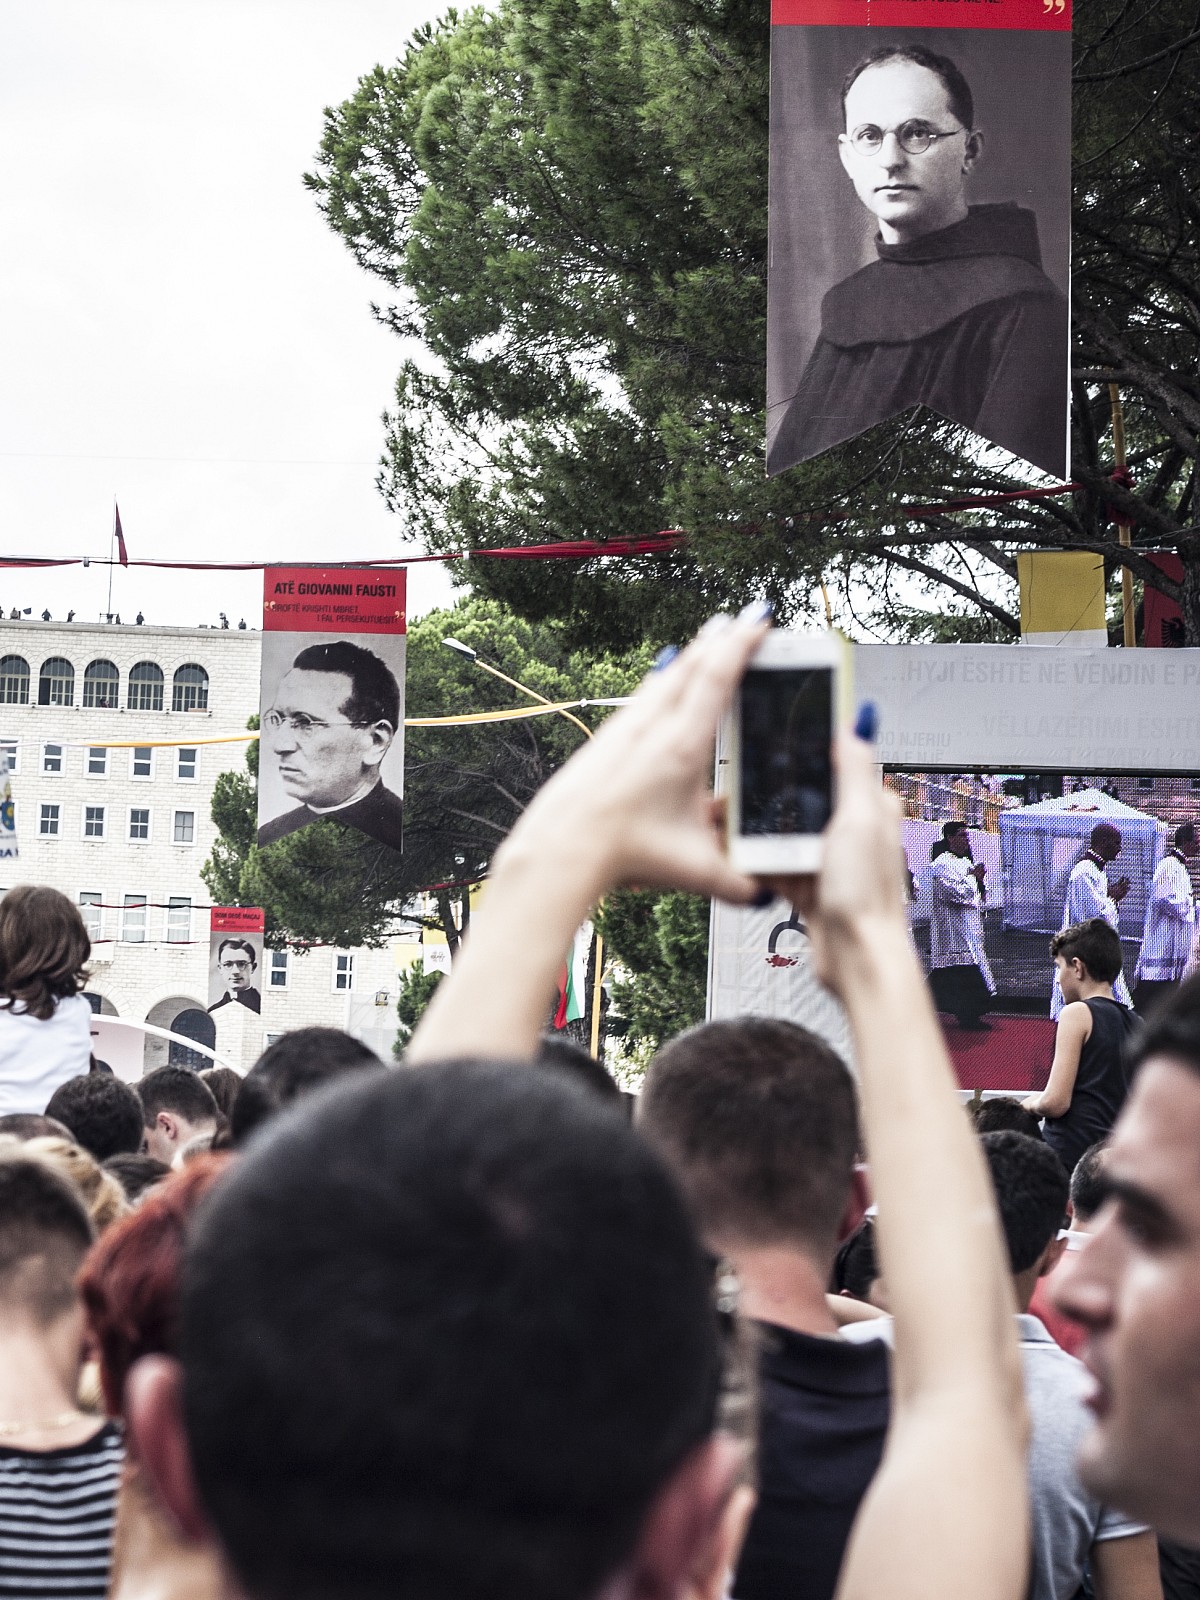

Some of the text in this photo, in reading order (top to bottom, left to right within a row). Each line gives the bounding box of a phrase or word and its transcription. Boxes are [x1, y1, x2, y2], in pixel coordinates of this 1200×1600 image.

[274, 580, 396, 598] ATË GIOVANNI FAUSTI
[963, 656, 1032, 684] ËSHTË
[1038, 657, 1066, 684] NË
[1073, 662, 1155, 685] VENDIN
[1163, 663, 1176, 686] E
[900, 731, 951, 747] NJERIU
